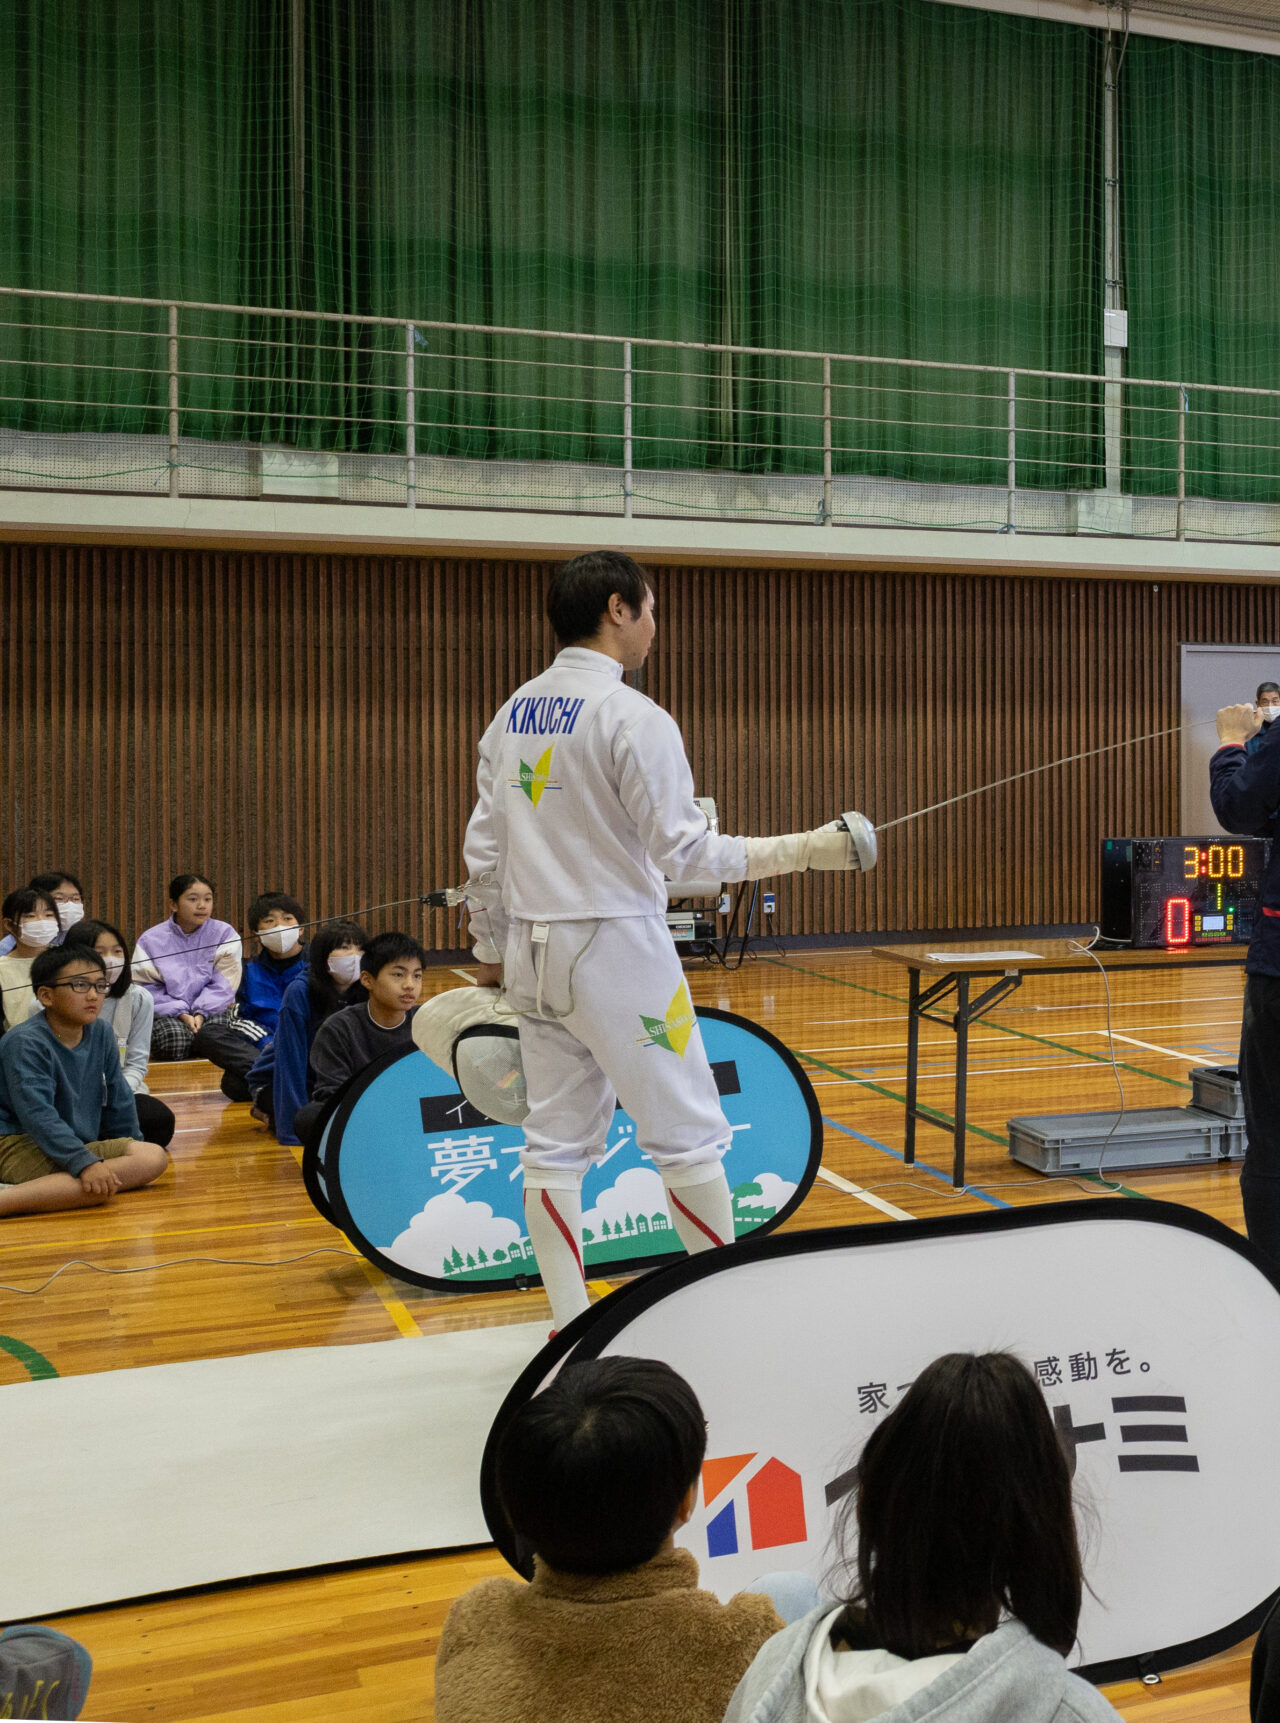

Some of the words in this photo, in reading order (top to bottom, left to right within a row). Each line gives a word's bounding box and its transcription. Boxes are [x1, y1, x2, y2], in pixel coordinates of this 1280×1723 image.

[505, 696, 586, 735] KIKUCHI
[1184, 844, 1244, 879] 3:00
[1166, 897, 1190, 943] 0
